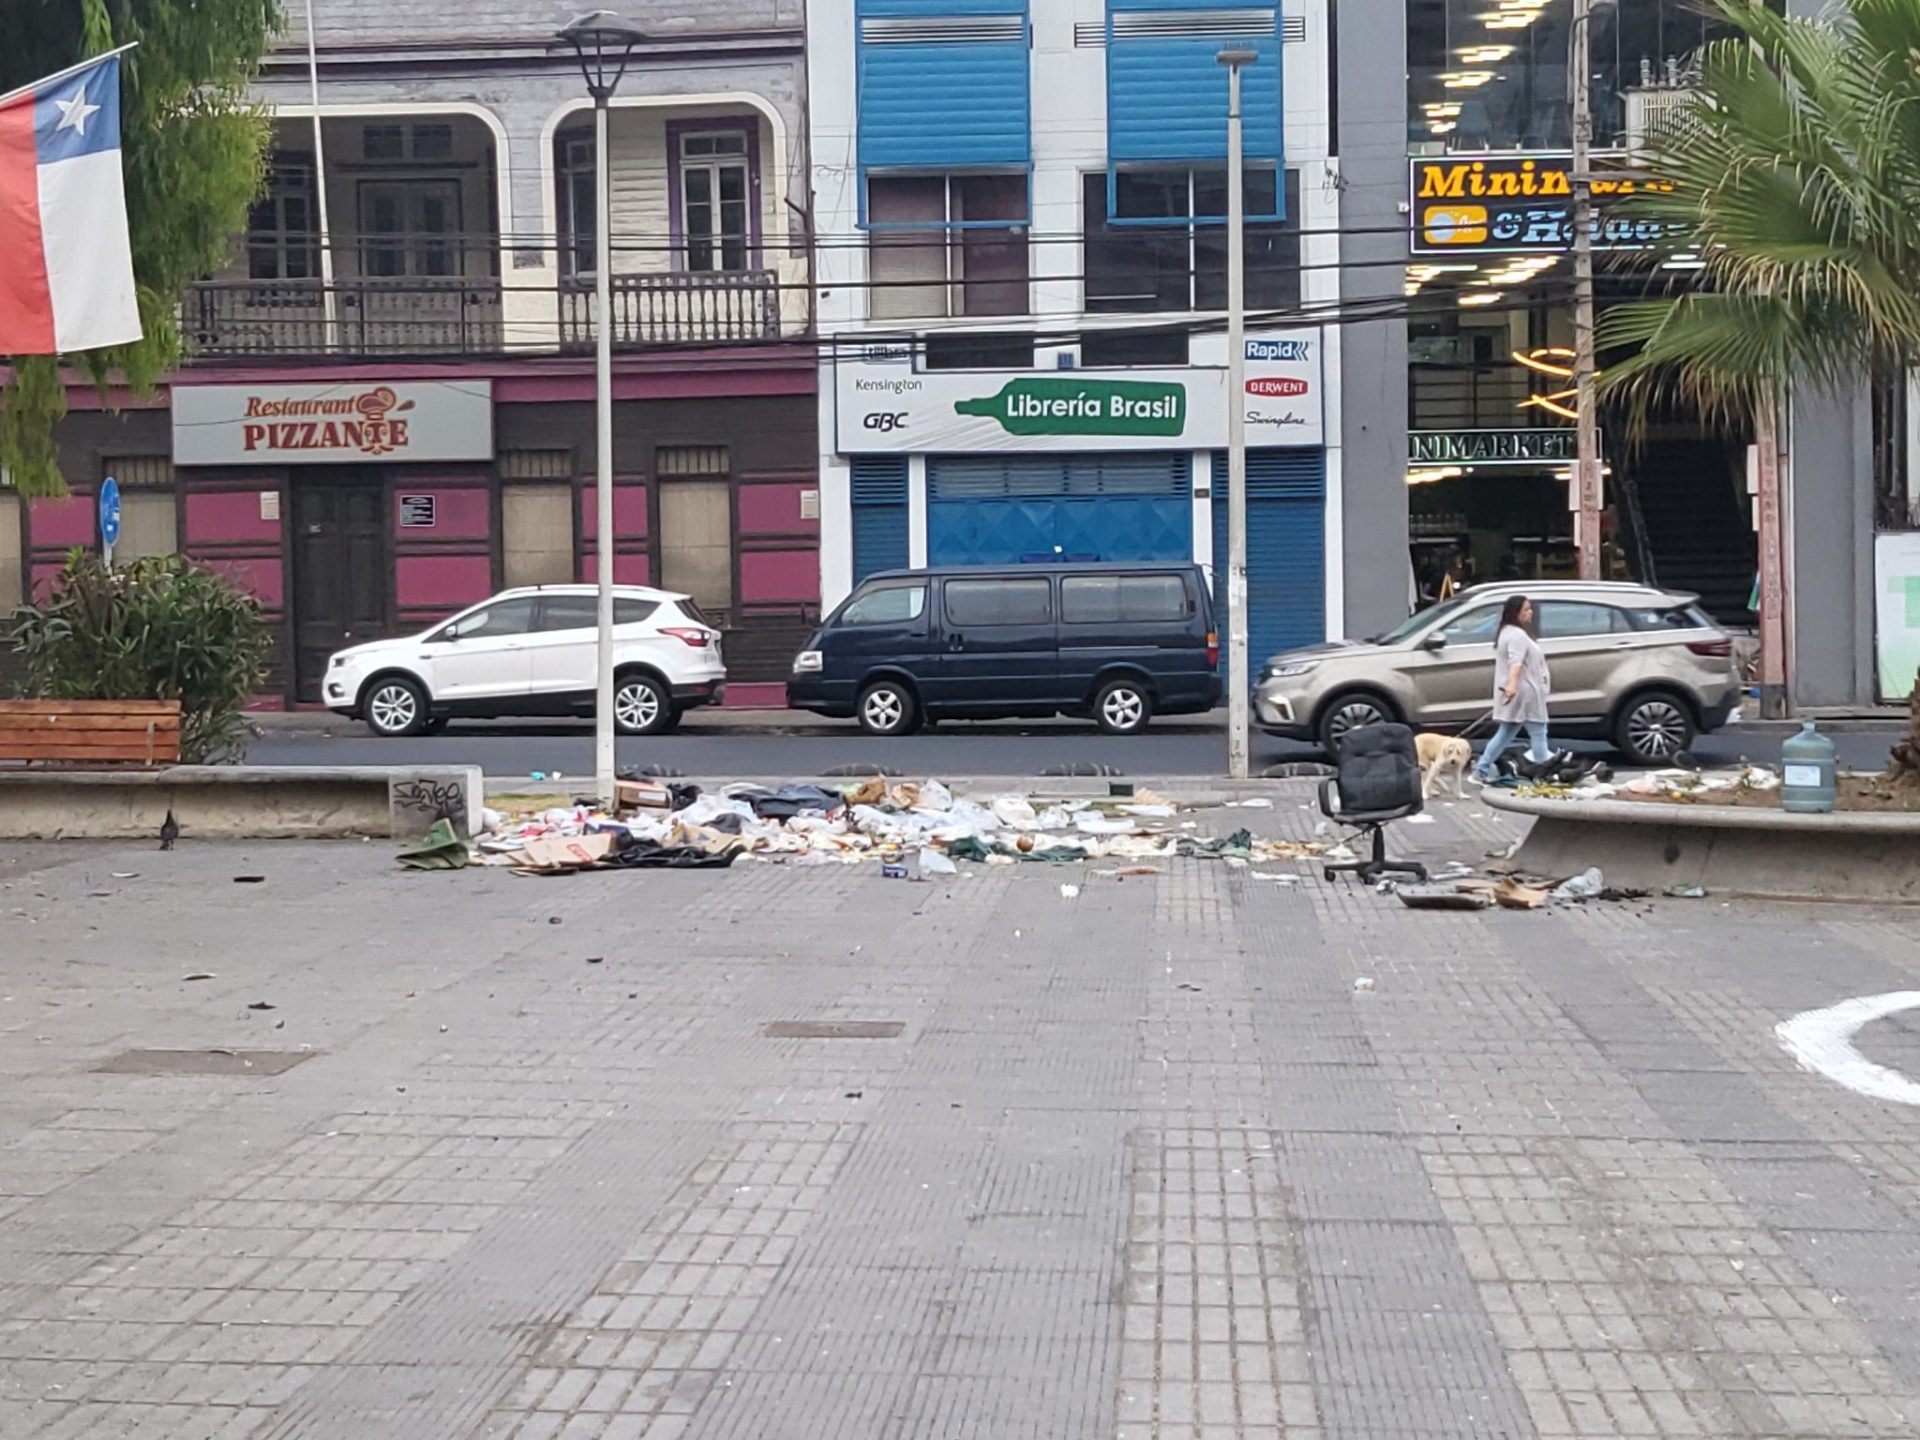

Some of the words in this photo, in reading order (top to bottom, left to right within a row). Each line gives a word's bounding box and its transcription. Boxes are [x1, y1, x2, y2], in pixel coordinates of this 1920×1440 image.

[1247, 341, 1293, 360] Rapid
[855, 378, 923, 395] Kensington
[1249, 381, 1305, 394] DERWENT
[243, 395, 356, 418] Restaurant
[1007, 391, 1101, 418] Librería
[1110, 394, 1177, 419] Brasil
[862, 411, 909, 433] GBC
[242, 419, 409, 452] PIZZANTE
